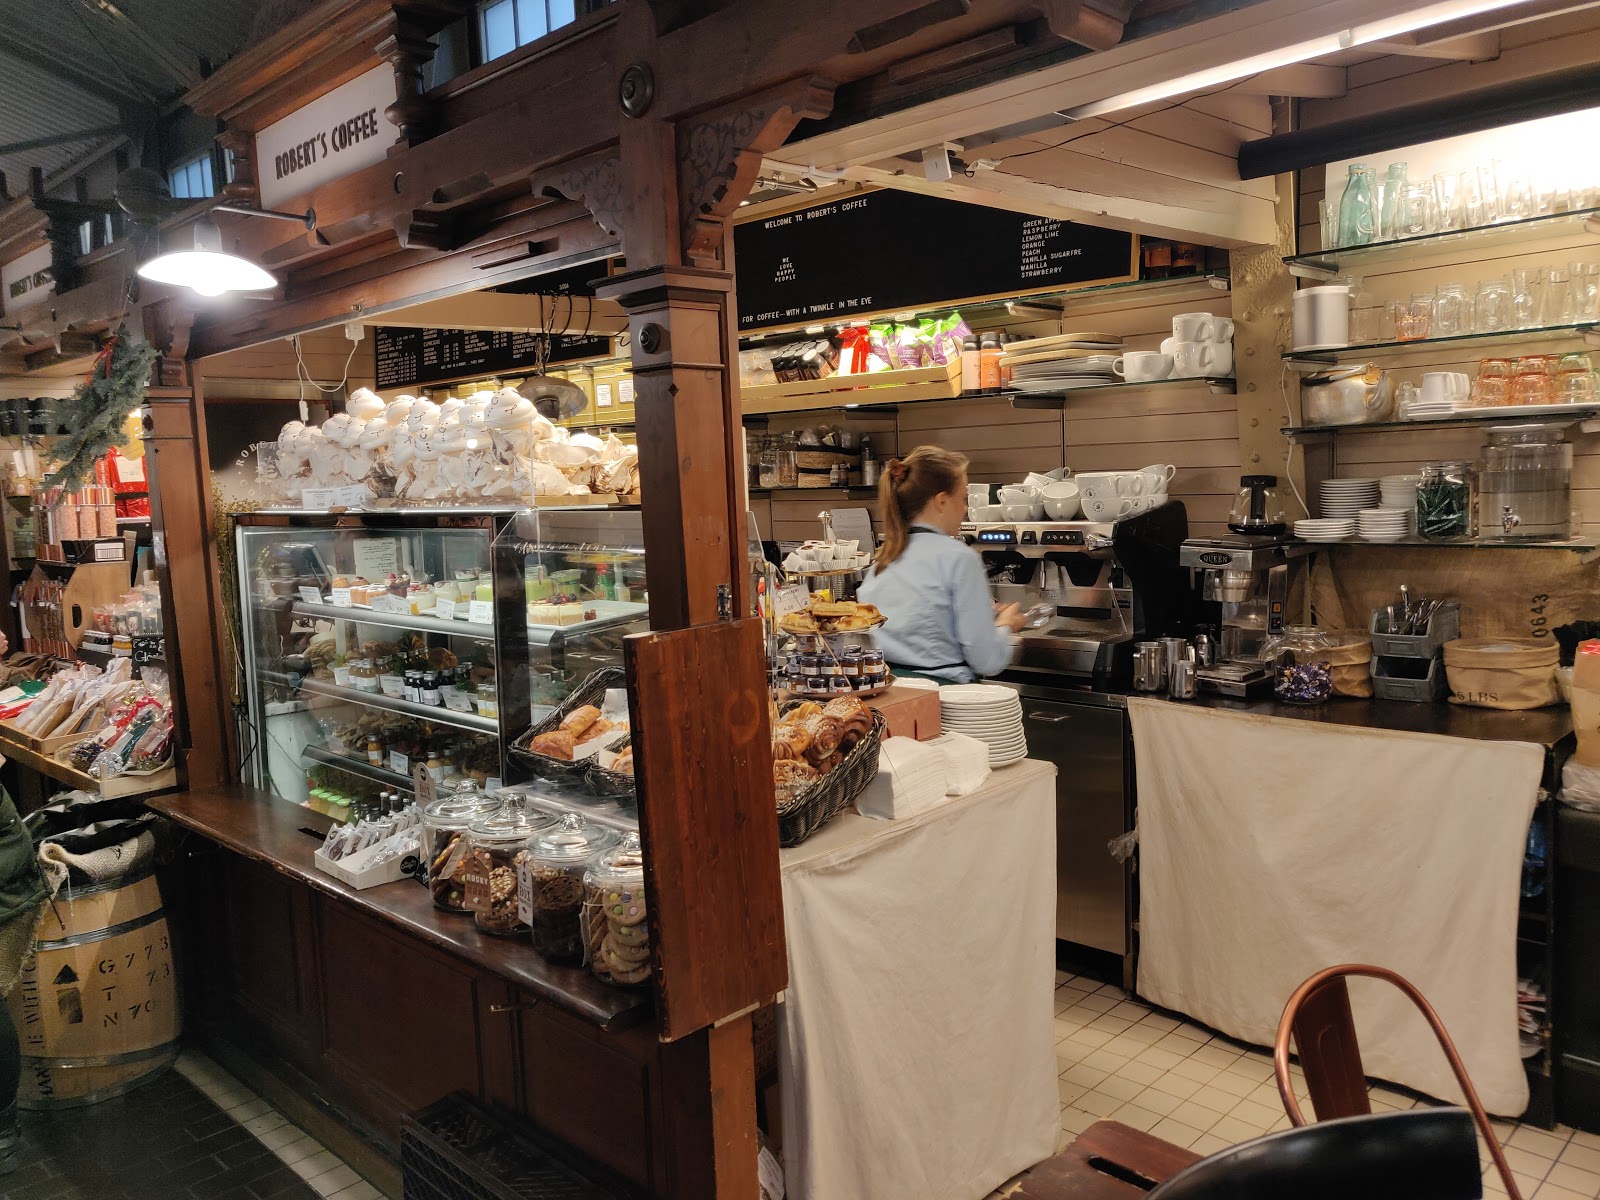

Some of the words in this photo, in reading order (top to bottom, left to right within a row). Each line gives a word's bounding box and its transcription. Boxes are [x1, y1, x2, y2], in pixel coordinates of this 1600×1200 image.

[275, 132, 328, 180] ROBERT'S
[331, 107, 378, 152] COFFEE
[764, 216, 793, 229] WELCOME
[795, 214, 803, 222] TO
[806, 206, 837, 220] ROBERT'S
[842, 198, 868, 211] COFFEE
[1022, 219, 1042, 228] GREEN
[1022, 223, 1062, 236] RASPBERRY
[1022, 233, 1043, 243] LEMON
[1044, 230, 1060, 239] LIME
[1021, 240, 1046, 250] ORANGE
[1021, 248, 1041, 257] PEACH
[1021, 254, 1048, 264] VANILLA
[779, 262, 793, 270] LOVE
[774, 273, 797, 283] PEOPLE
[776, 268, 795, 277] HAPPY
[1021, 266, 1063, 279] STRAWBERRY
[742, 315, 754, 324] FOR
[810, 302, 835, 313] TWINKLE
[838, 301, 845, 309] IN
[847, 298, 858, 307] THE
[860, 296, 872, 306] EYE
[1203, 554, 1228, 563] QUEEN
[1530, 594, 1550, 638] 0643
[1468, 692, 1504, 703] LBS.
[466, 873, 488, 886] ROCKY
